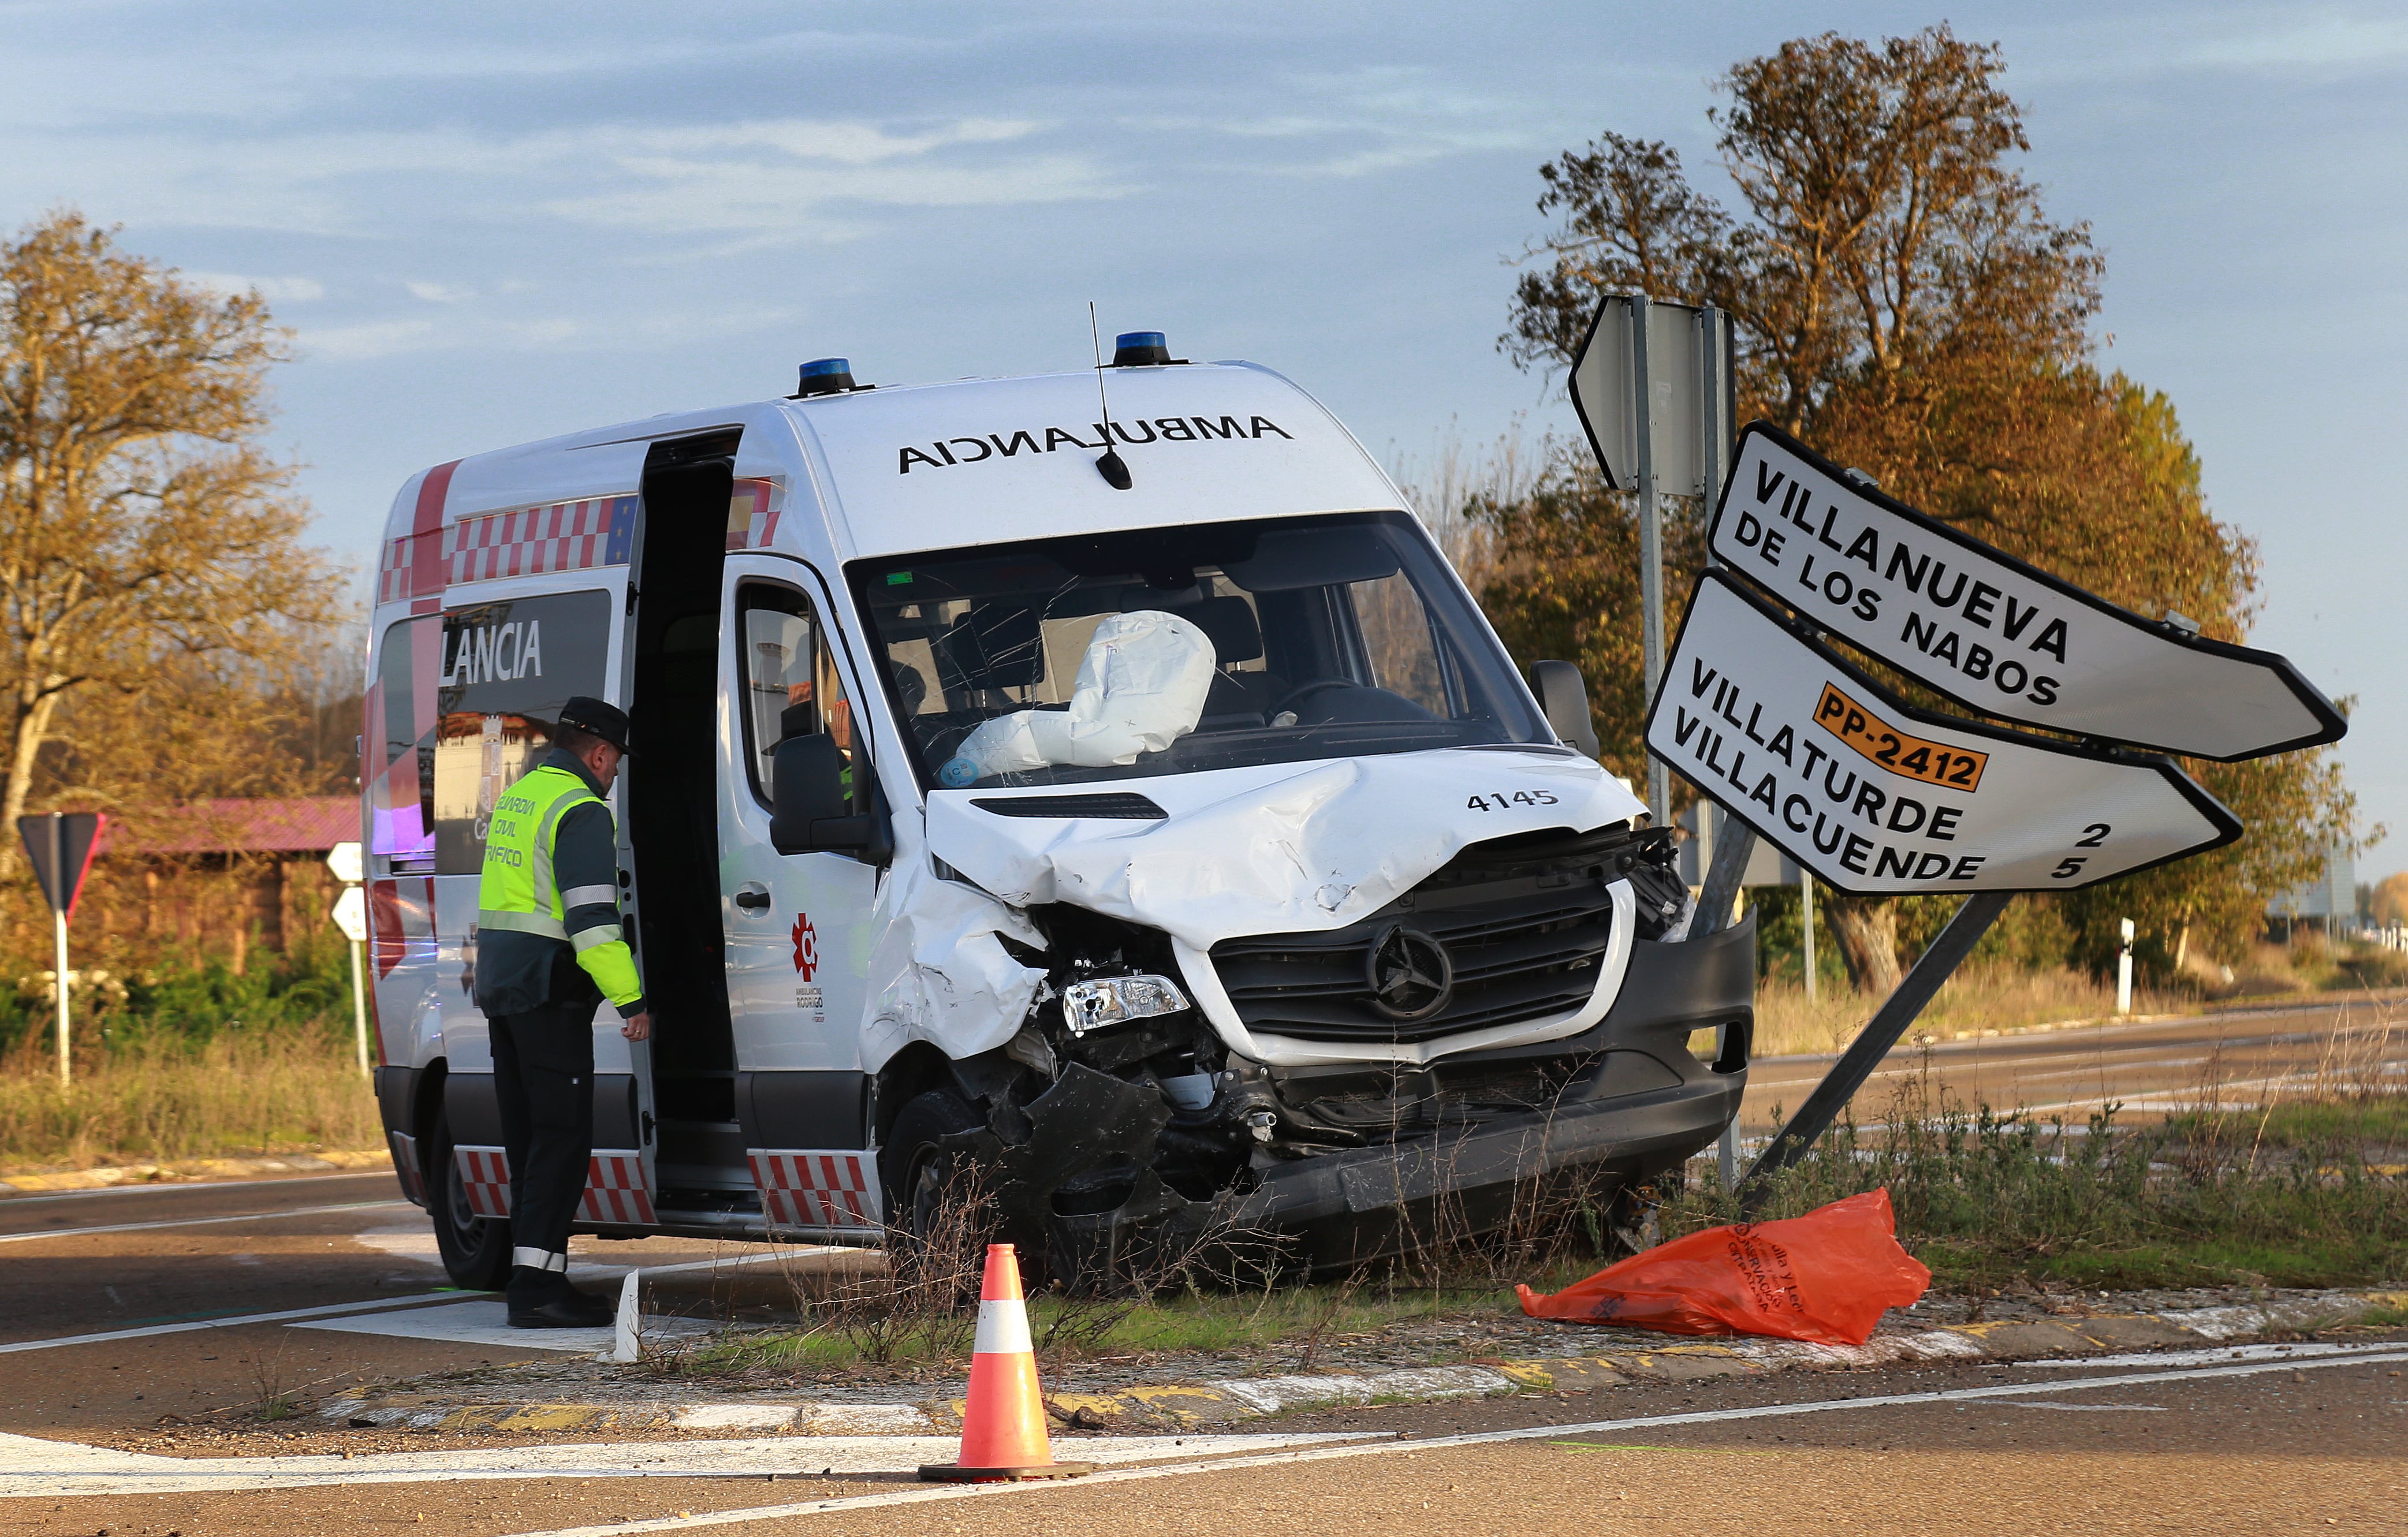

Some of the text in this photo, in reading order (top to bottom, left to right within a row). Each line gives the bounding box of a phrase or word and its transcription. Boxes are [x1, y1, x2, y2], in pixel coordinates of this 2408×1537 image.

[1734, 510, 2061, 706] DE LOS NABOS
[1757, 459, 2067, 664] VILLANUEVA
[439, 620, 542, 687] LANCIA
[1692, 656, 2111, 848] VILLATURDE 2
[1819, 691, 1977, 786] PP-2412
[495, 819, 516, 837] CIVIL
[1467, 789, 1560, 812] 4145
[1675, 705, 2088, 880] VILLACUENDE 5
[797, 997, 823, 1008] RODRIGO
